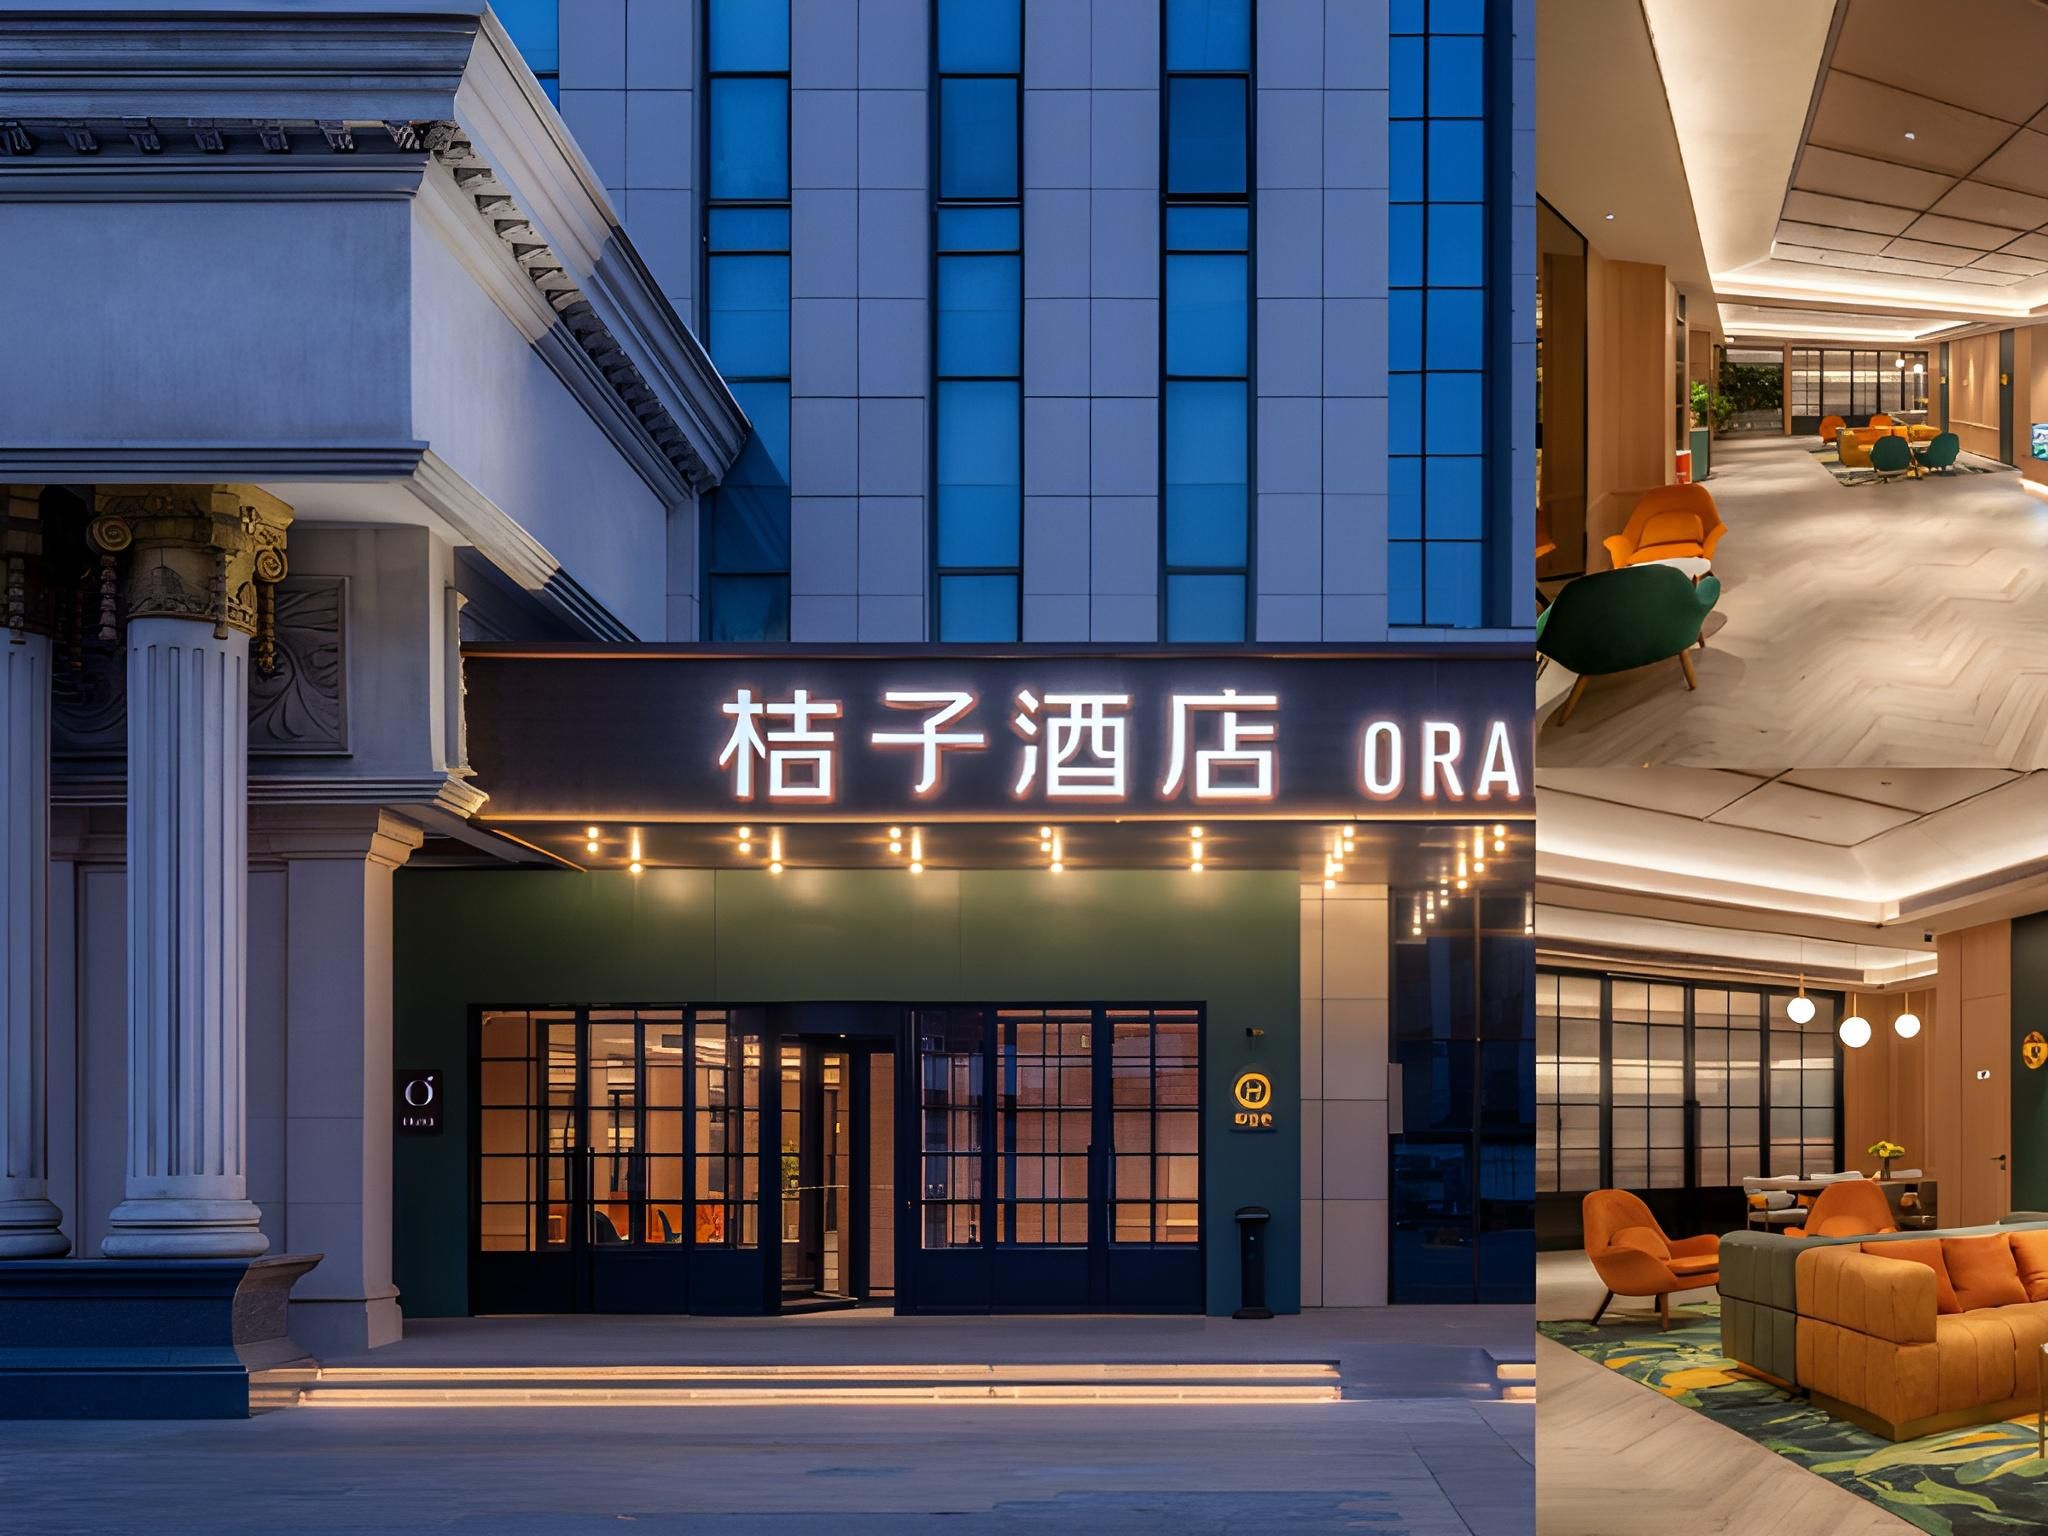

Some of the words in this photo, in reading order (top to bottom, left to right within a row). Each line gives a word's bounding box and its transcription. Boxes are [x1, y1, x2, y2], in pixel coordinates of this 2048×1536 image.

[718, 688, 1278, 798] 桔子酒店
[1363, 720, 1521, 797] ORA
